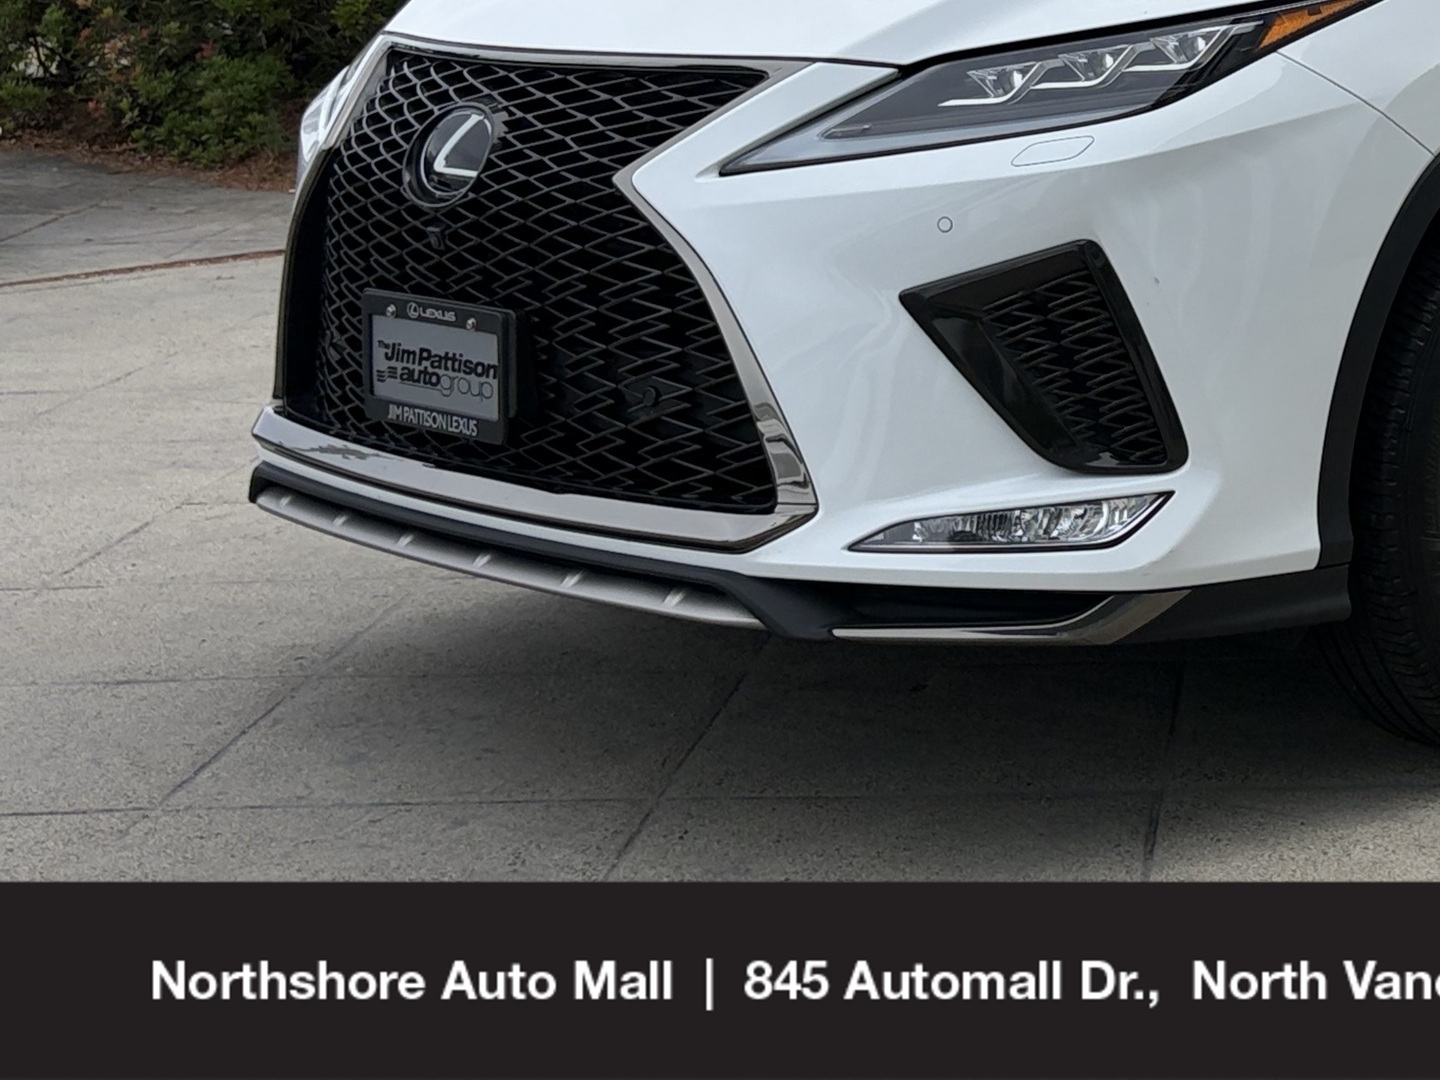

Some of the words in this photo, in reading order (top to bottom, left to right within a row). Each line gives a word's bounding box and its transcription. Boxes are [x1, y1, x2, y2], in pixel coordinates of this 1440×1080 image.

[420, 307, 457, 321] LEXUS
[388, 404, 403, 421] JIM
[404, 407, 447, 431] PATTISON
[448, 417, 479, 437] LEXUS
